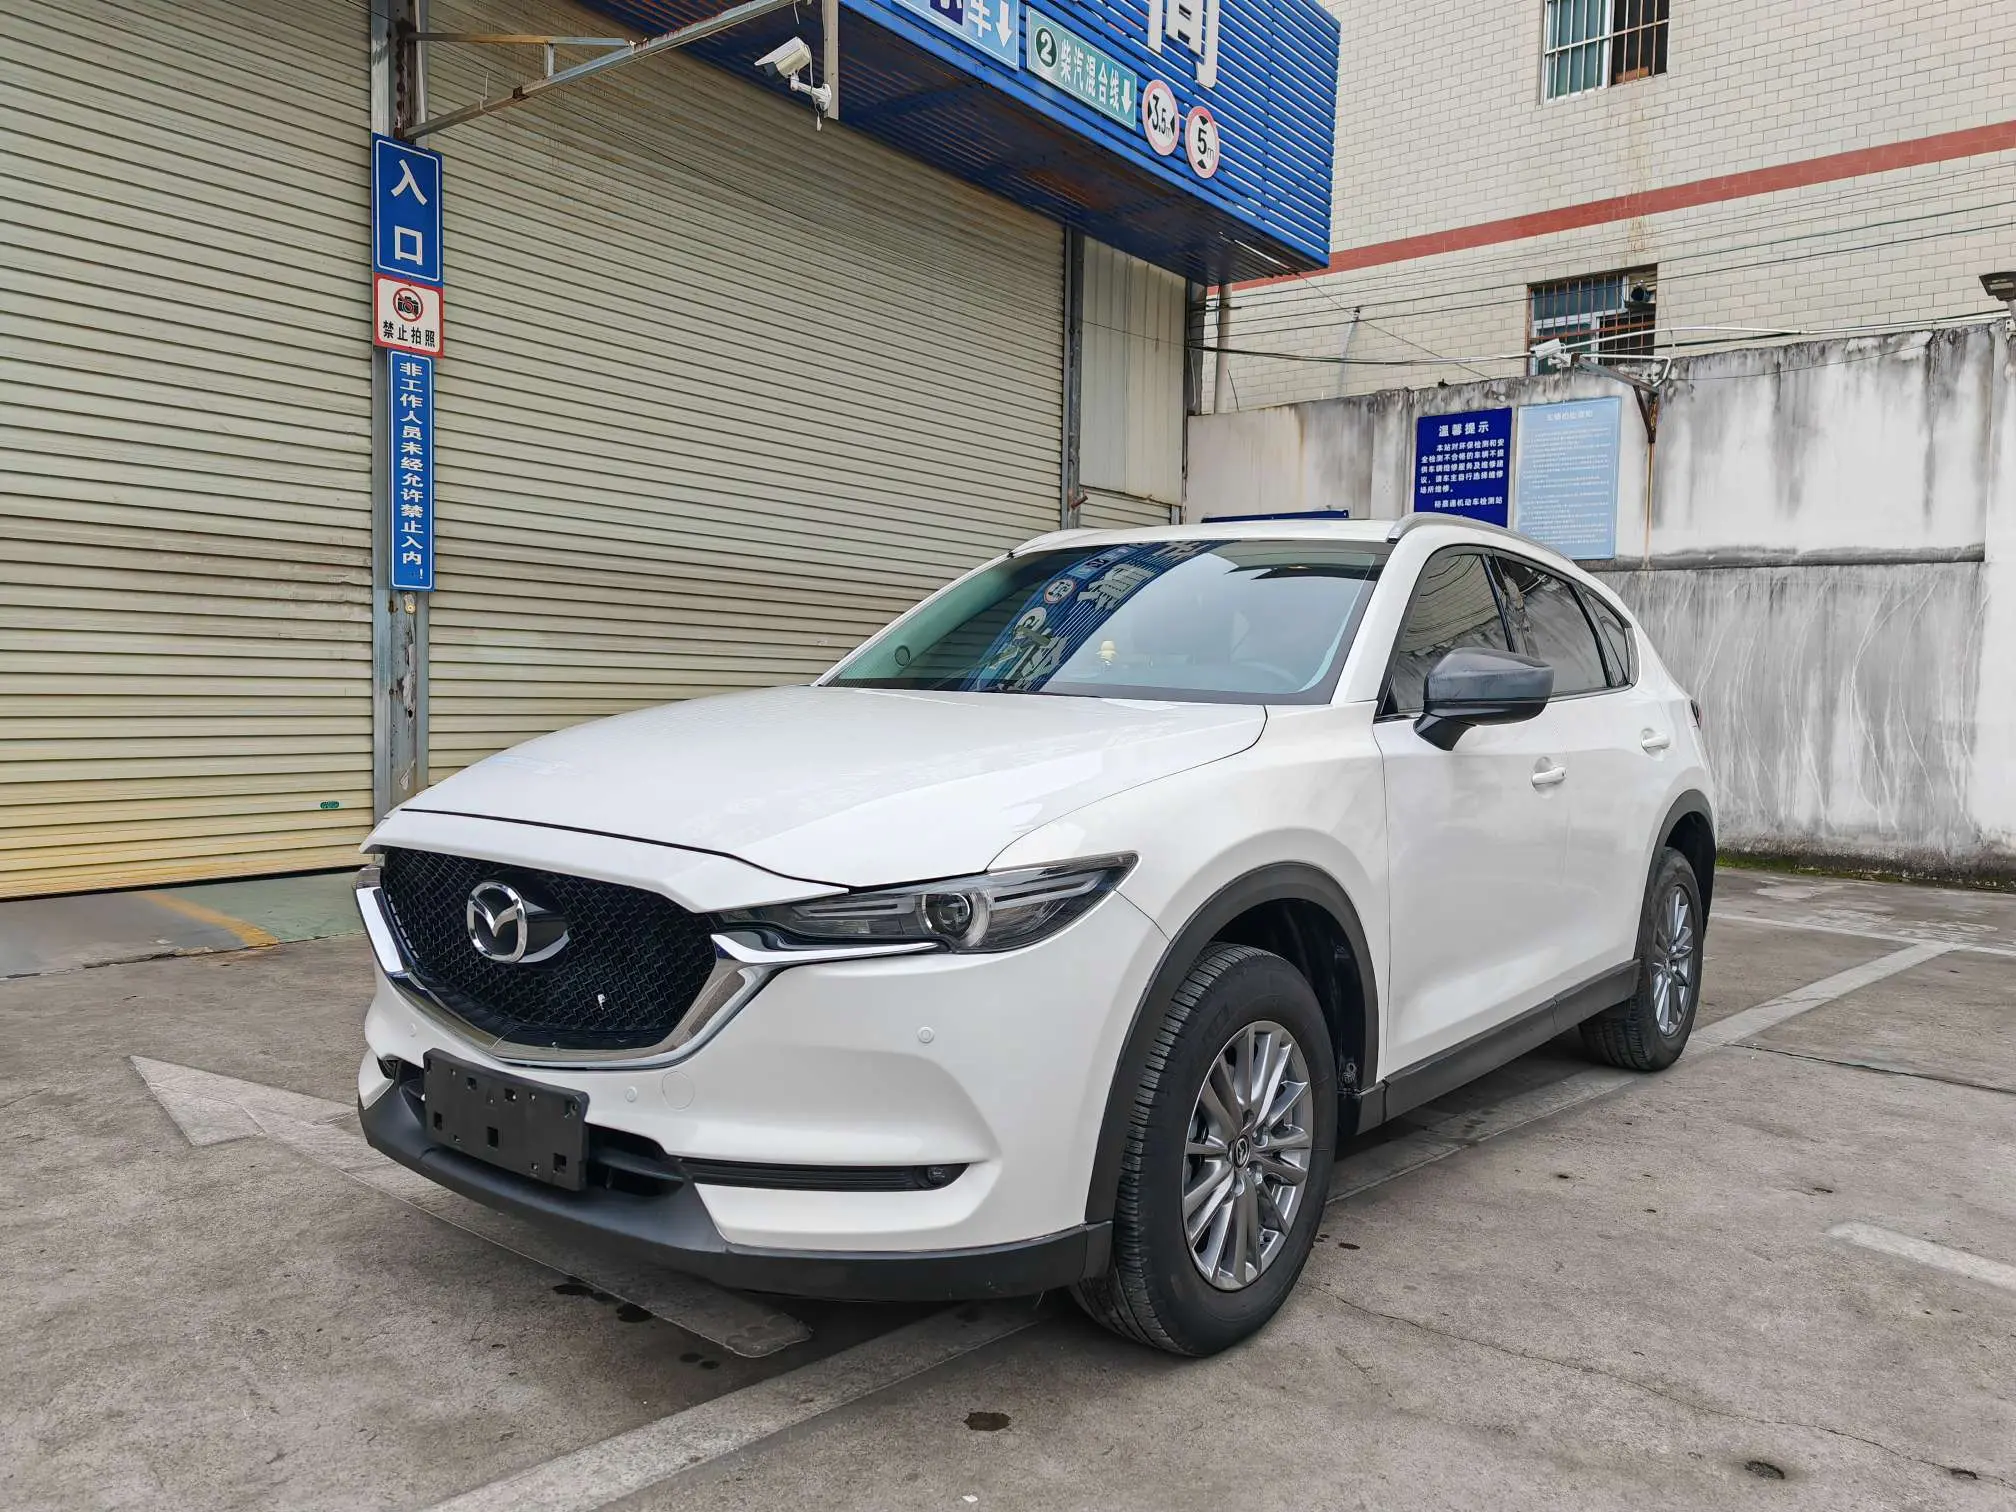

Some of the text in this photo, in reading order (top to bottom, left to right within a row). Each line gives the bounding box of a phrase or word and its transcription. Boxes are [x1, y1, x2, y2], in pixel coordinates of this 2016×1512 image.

[390, 159, 428, 266] 入口
[382, 320, 435, 348] 禁止拍照
[1438, 421, 1489, 437] 温馨提示
